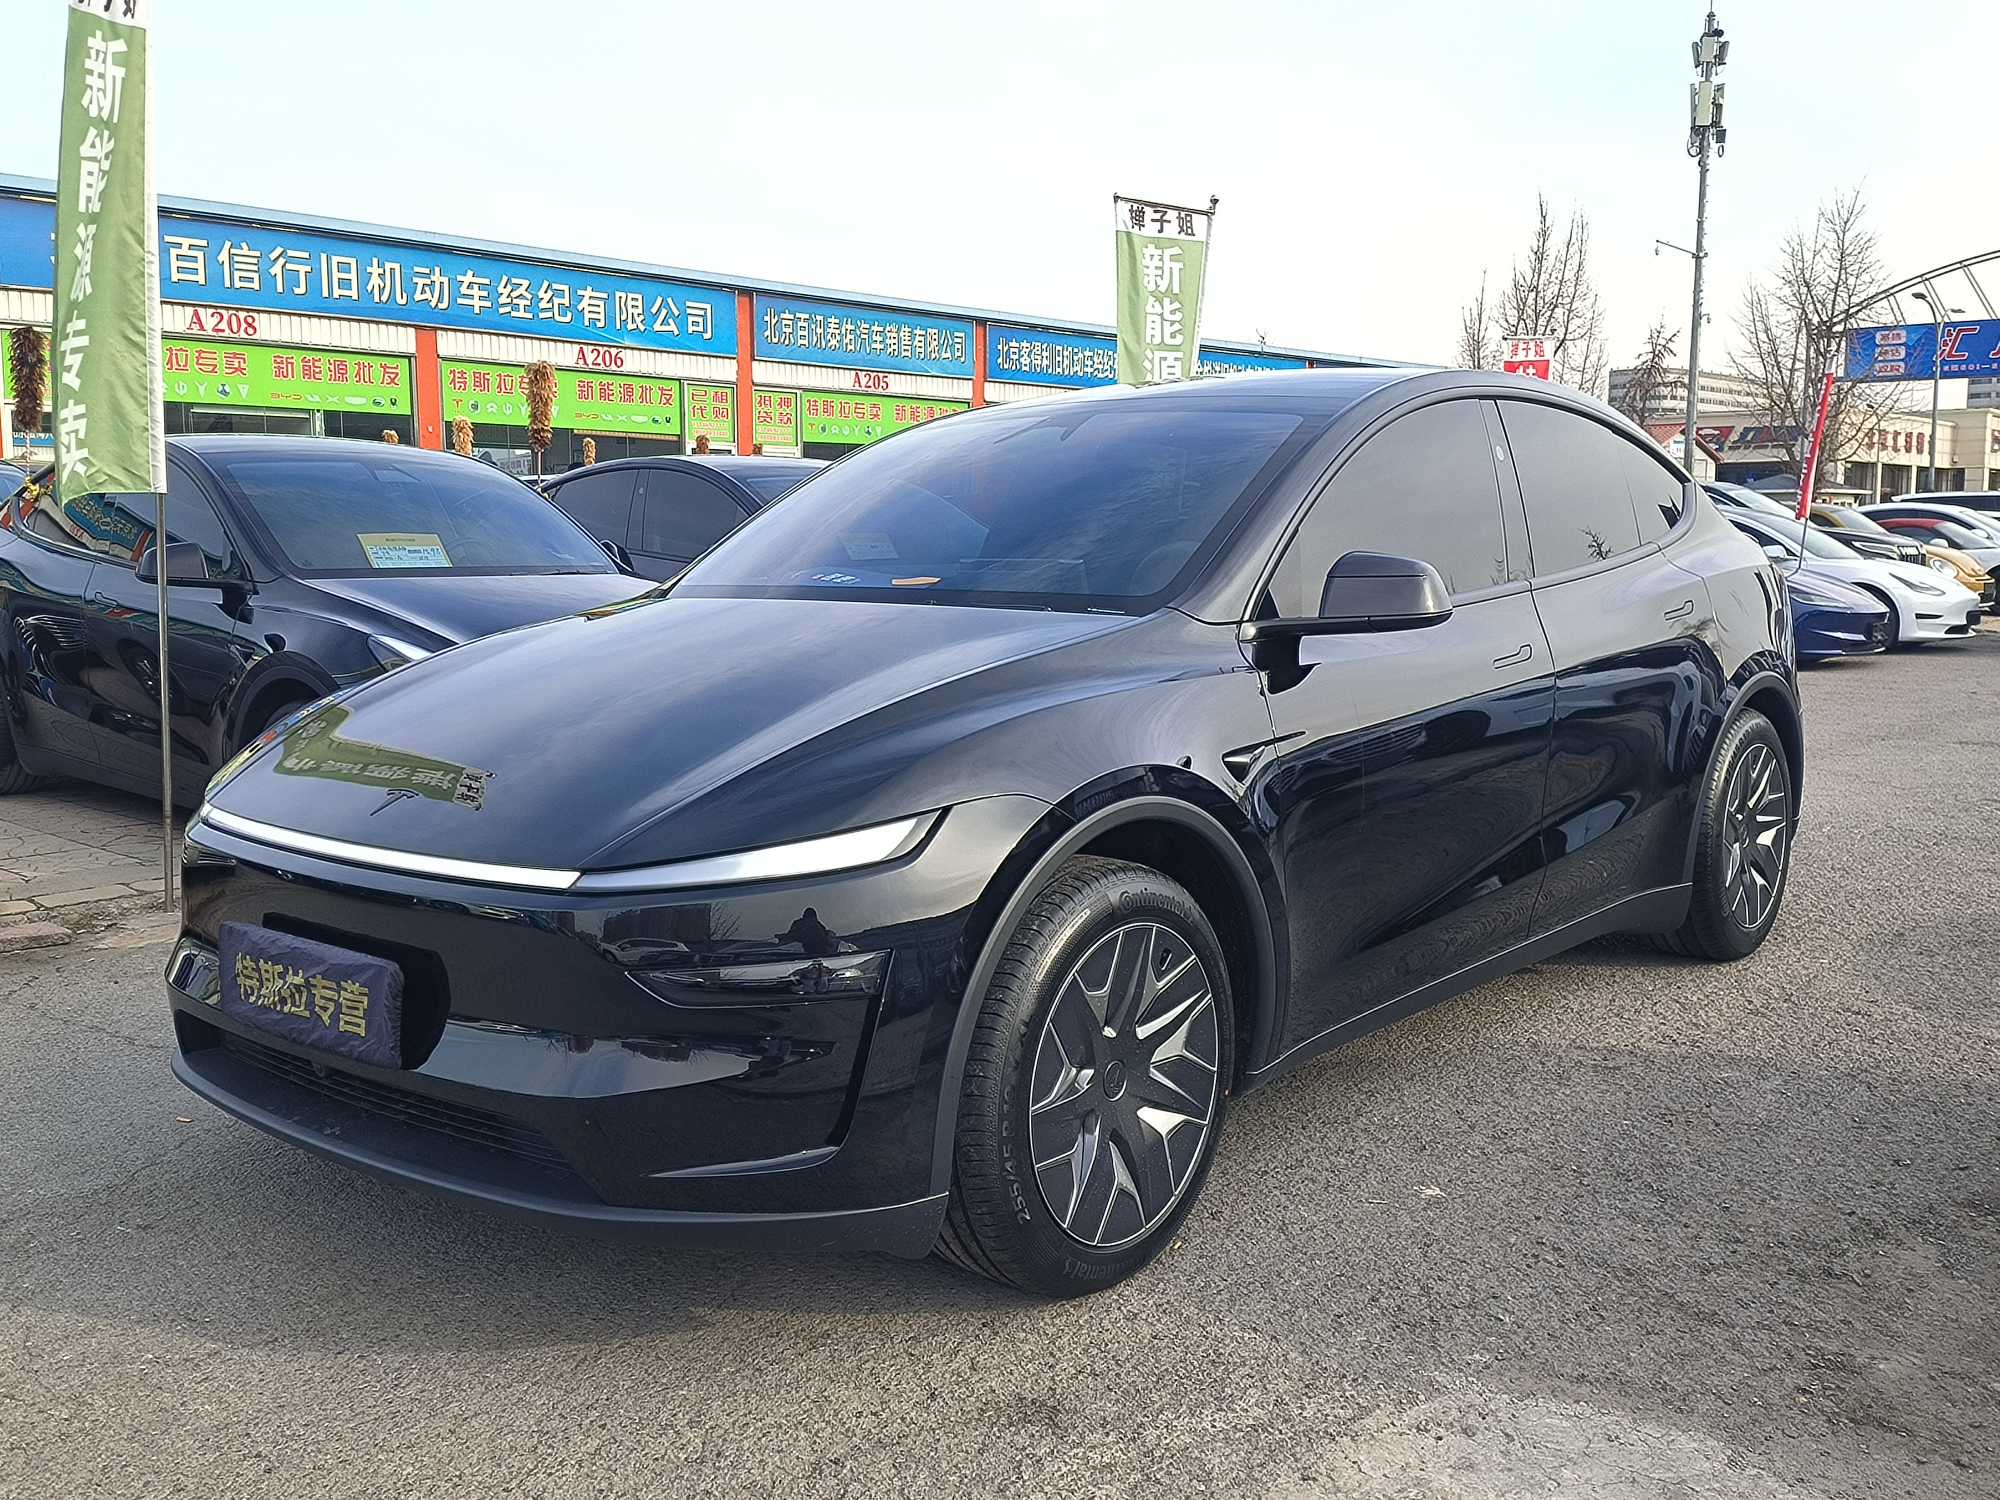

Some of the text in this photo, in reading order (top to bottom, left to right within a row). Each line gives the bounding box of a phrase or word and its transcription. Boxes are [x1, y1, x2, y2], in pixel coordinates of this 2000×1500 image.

[60, 29, 129, 484] 新能源专卖
[163, 234, 714, 342] 百信行旧机动车经纪有限公司
[186, 308, 257, 337] A208
[1142, 242, 1184, 384] 新能源
[165, 346, 401, 388] 拉专卖 新能源批发
[575, 345, 625, 370] A206
[996, 336, 1117, 380] 北京客得利旧机动车经纪
[577, 379, 674, 407] 新能源批发
[852, 371, 890, 391] A205
[806, 398, 960, 423] 特斯拉专卖 新能源
